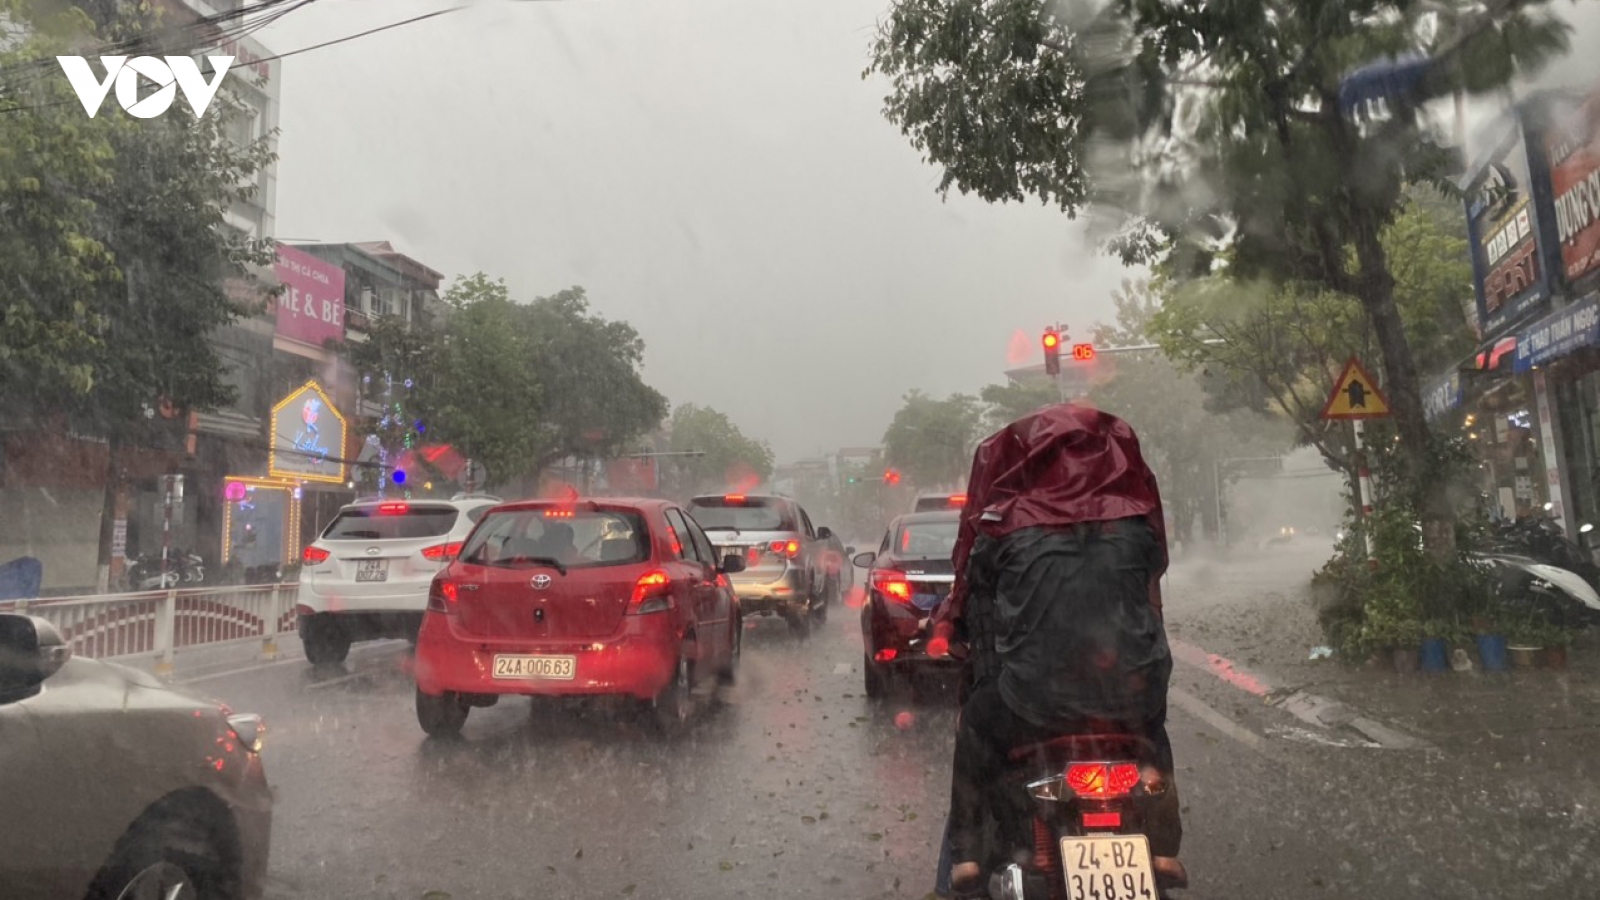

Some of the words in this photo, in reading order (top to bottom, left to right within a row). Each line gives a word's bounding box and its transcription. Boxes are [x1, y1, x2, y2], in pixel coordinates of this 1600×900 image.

[1484, 237, 1536, 314] SPORT
[303, 293, 319, 320] &
[321, 297, 342, 326] BÉ
[1074, 346, 1093, 360] 06
